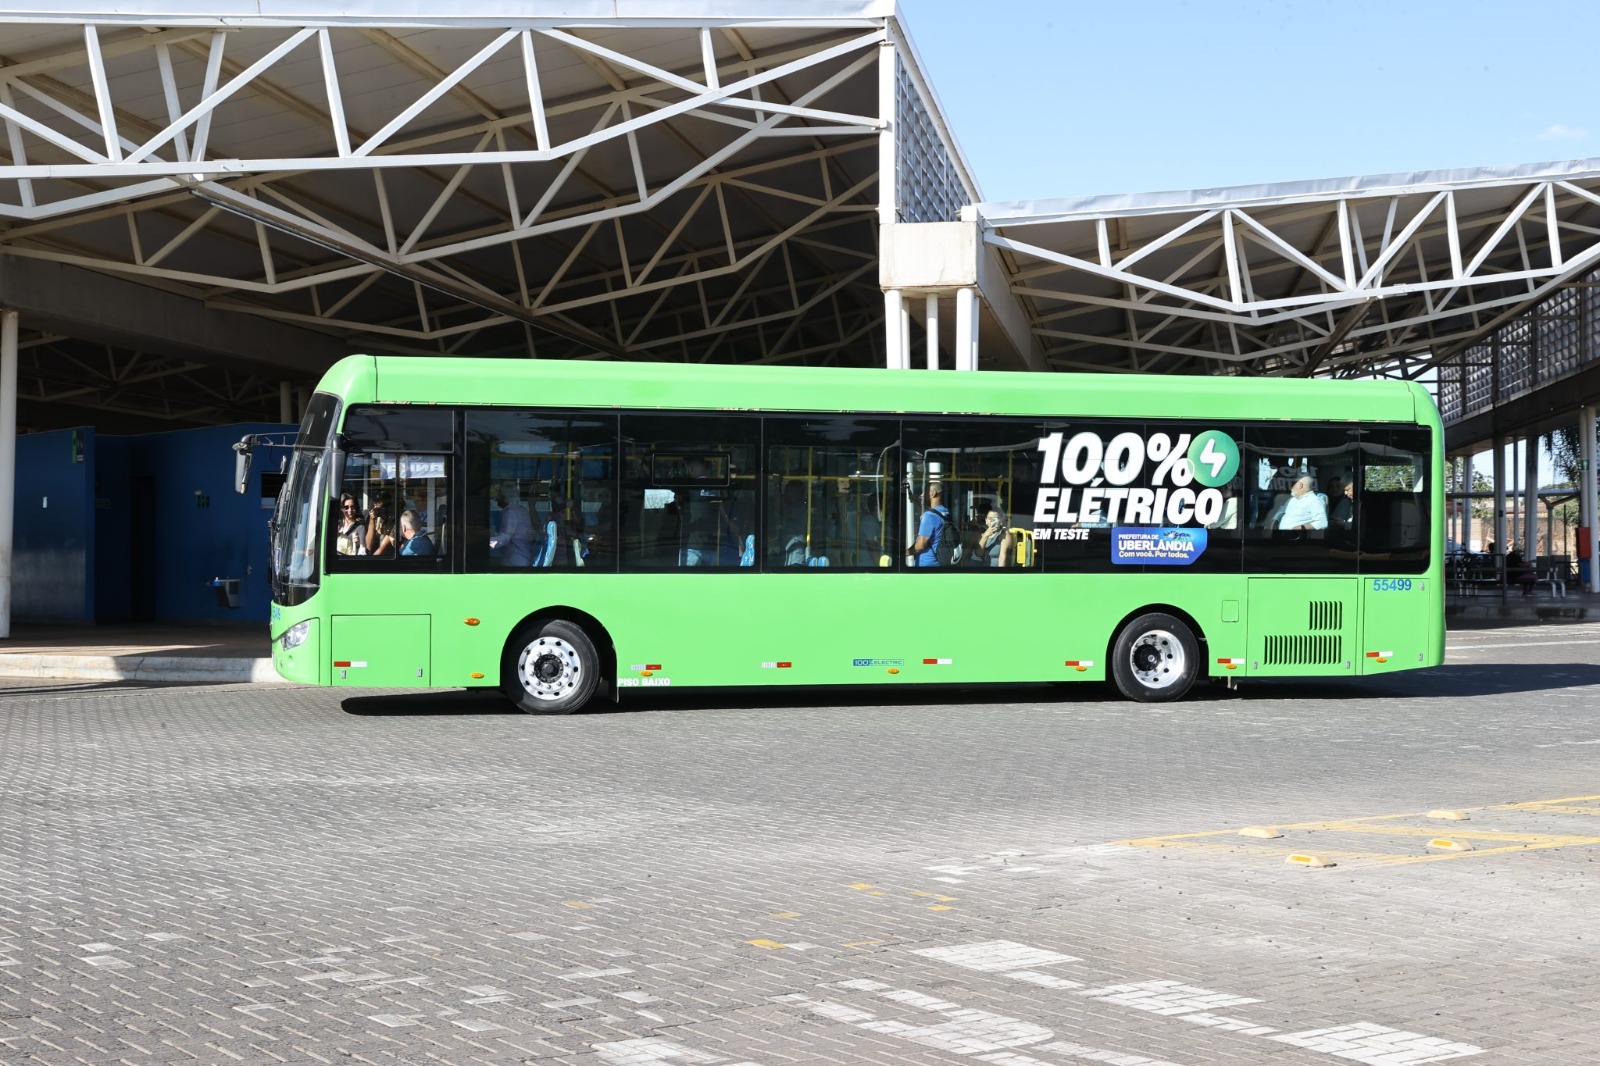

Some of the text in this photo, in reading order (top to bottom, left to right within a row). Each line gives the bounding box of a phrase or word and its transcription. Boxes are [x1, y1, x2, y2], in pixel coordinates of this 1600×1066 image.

[1037, 431, 1195, 487] 100%
[1033, 477, 1223, 525] ELÉTRICO
[1033, 528, 1090, 540] EM TESTE
[1118, 539, 1194, 551] UBERLÂNDIA
[1168, 551, 1189, 559] todos.
[1373, 577, 1412, 591] 55499
[617, 678, 670, 686] PISO BAIXO
